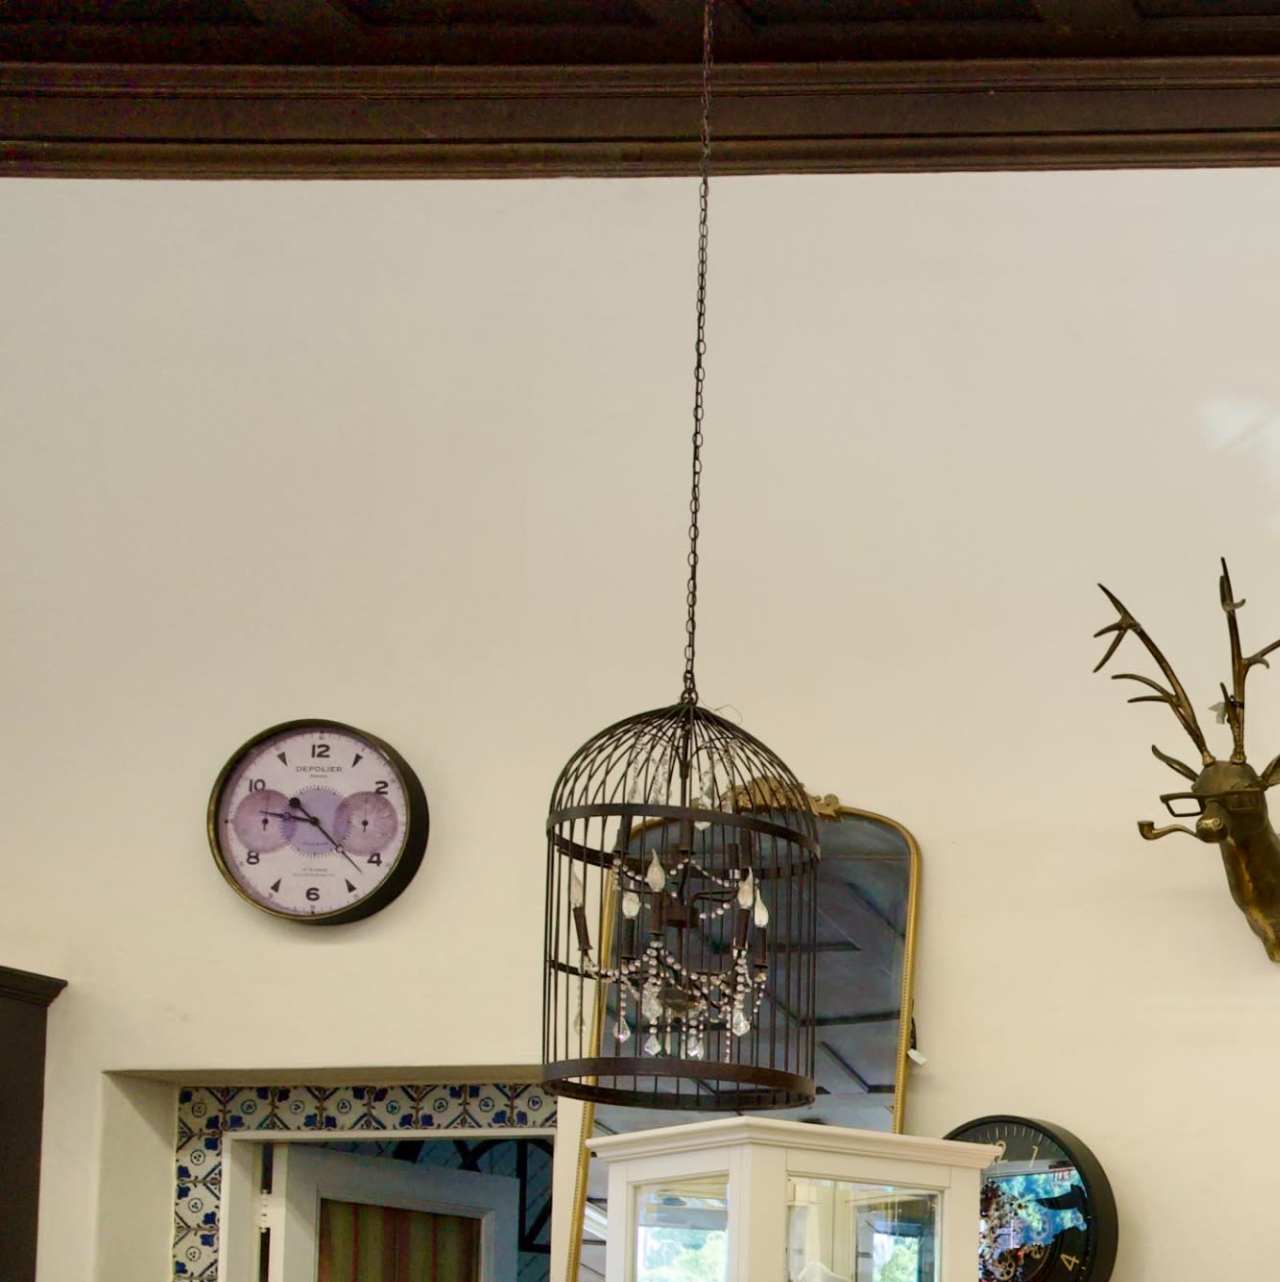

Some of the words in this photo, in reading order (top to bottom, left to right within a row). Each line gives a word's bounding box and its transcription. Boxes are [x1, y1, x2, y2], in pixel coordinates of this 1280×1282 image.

[311, 743, 331, 759] 12
[248, 779, 266, 793] 10
[374, 781, 389, 795] 2
[246, 851, 260, 865] 8
[367, 852, 383, 866] 4
[305, 887, 320, 901] 6
[1027, 1145, 1039, 1169] 1
[1060, 1252, 1080, 1272] 4
